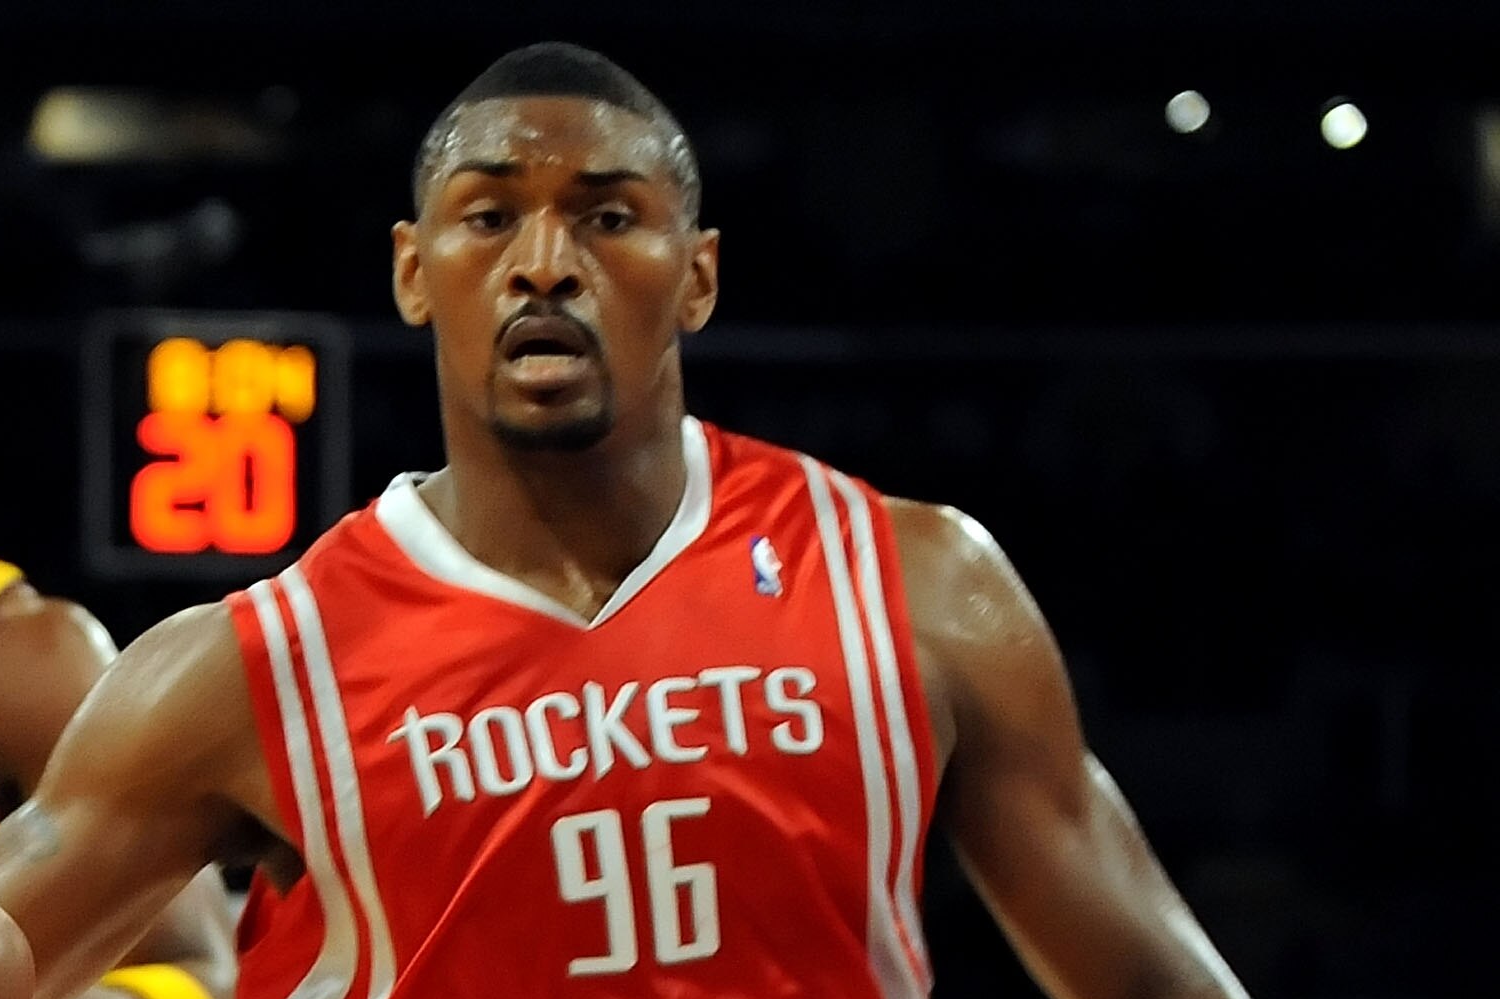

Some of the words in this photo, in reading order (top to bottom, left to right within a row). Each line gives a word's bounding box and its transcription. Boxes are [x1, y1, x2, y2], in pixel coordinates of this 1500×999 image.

[130, 411, 297, 555] 20
[386, 666, 825, 819] ROCKETS
[550, 796, 722, 979] 96
